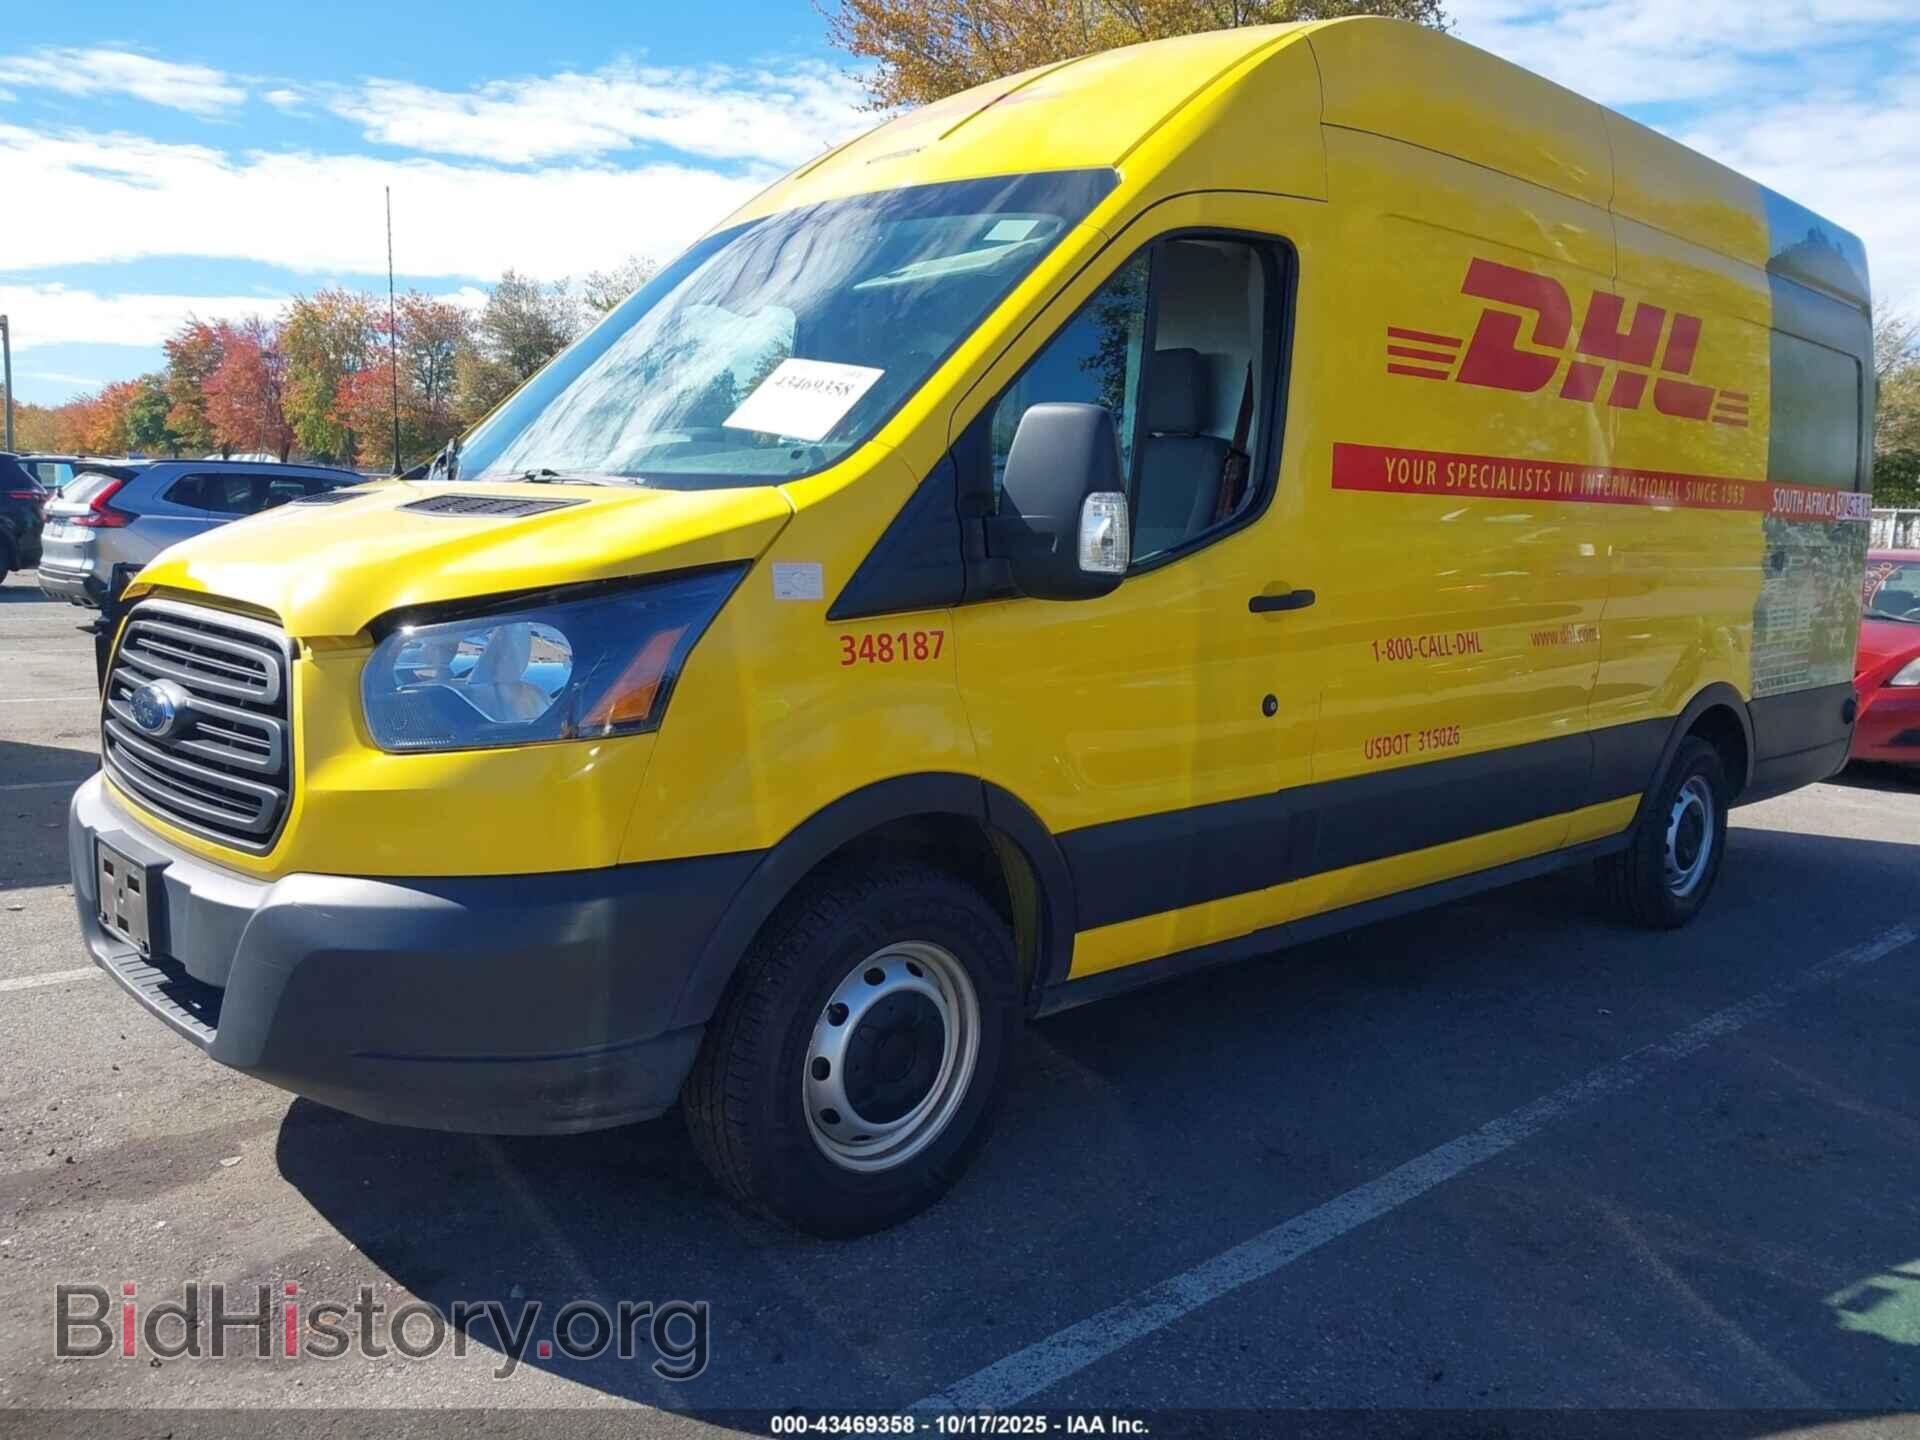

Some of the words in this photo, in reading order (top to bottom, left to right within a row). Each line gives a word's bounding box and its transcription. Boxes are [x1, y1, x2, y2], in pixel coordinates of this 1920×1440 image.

[1456, 257, 1716, 421] DHL
[1385, 456, 1438, 486] YOUR
[1446, 461, 1551, 493] SPECIALISTS
[1558, 470, 1575, 495] IN
[1580, 472, 1680, 501] INTERNATIONAL
[1686, 480, 1718, 503] SINCE
[1772, 487, 1804, 513] SOUTH
[839, 630, 945, 666] 348187
[1371, 631, 1484, 663] 1-800-CALL-DHL
[1364, 733, 1412, 761] USDOT
[1418, 725, 1461, 752] 315026
